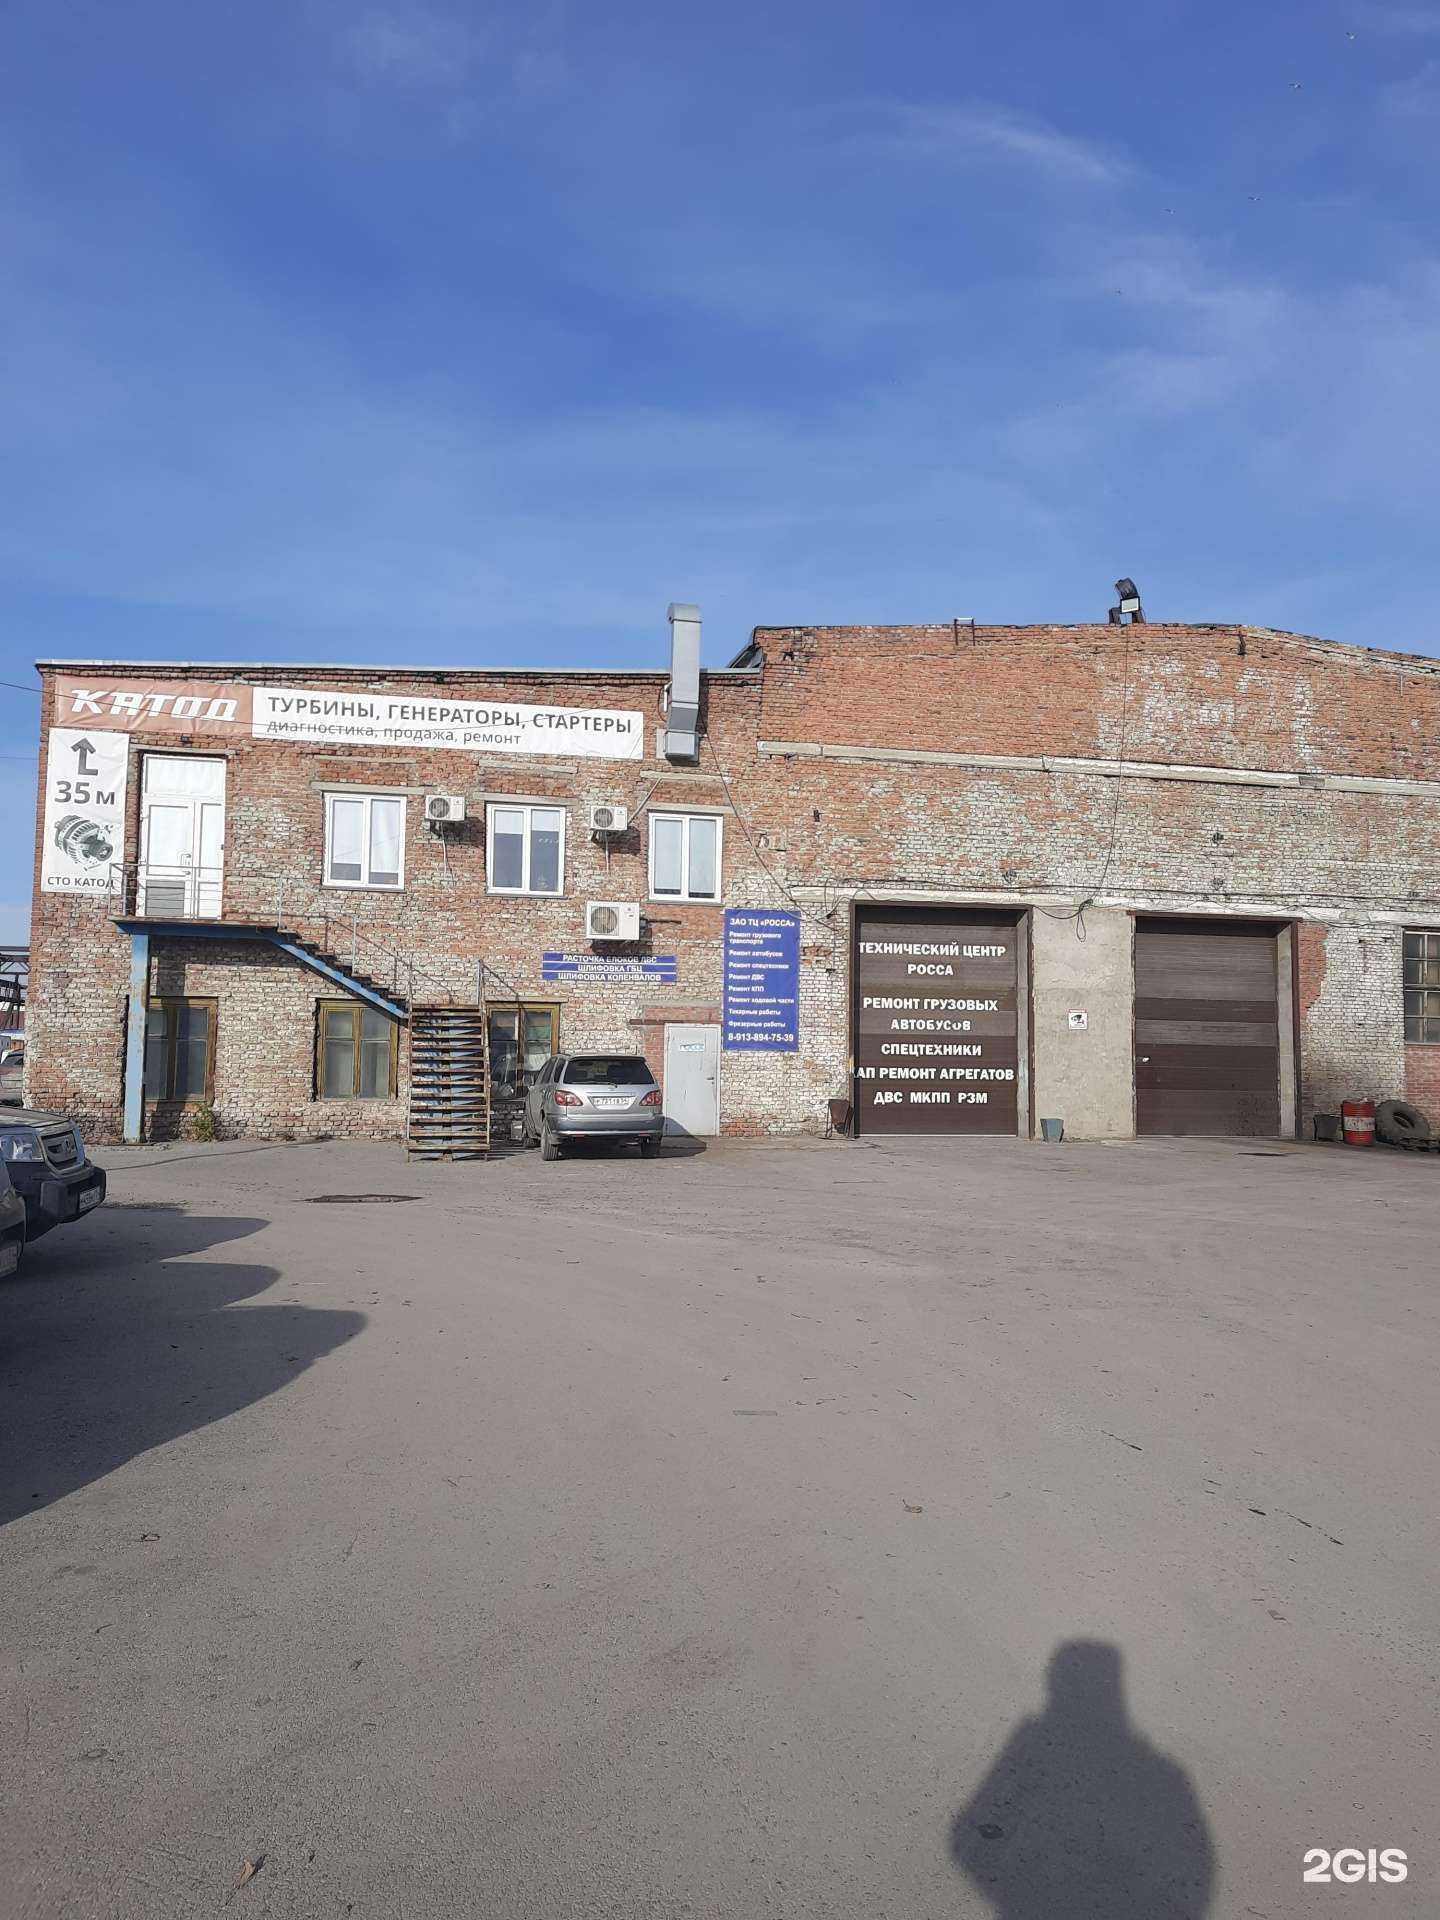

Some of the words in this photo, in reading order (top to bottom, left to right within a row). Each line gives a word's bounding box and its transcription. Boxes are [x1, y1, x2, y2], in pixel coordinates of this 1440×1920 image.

[71, 689, 239, 721] КАТОД
[268, 696, 380, 720] ТУРБИНЫ,
[388, 704, 526, 730] ГЕНЕРАТОРЫ,
[533, 713, 631, 733] СТАРТЕРЫ
[267, 720, 378, 738] диагностика,
[384, 728, 458, 743] продажа,
[463, 732, 522, 745] ремонт
[54, 780, 91, 804] 35
[47, 876, 71, 886] СТО
[74, 877, 114, 890] КАТОД
[729, 918, 747, 926] ЗАО
[748, 919, 759, 927] ТЦ
[760, 919, 796, 927] «РОССА»
[858, 941, 959, 956] ТЕХНИЧЕСКИЙ
[963, 945, 1006, 958] ЦЕНТР
[562, 954, 604, 963] РАСТОЧКА
[577, 963, 625, 972] ШЛИФОВКА
[626, 964, 643, 973] ГБЦ
[907, 963, 954, 976] РОССА
[558, 972, 606, 981] ШЛИФОВКА
[607, 973, 662, 981] КОЛЕНВАЛОВ
[863, 997, 920, 1009] РЕМОНТ
[924, 998, 999, 1011] ГРУЗОВЫХ
[728, 1032, 794, 1042] 8-913-894-75-39
[881, 1043, 982, 1057] СПЕЦТЕХНИКИ
[855, 1067, 875, 1079] АП
[879, 1067, 936, 1079] РЕМОНТ
[940, 1069, 1014, 1080] АГРЕГАТОВ
[873, 1091, 903, 1104] ДВС
[910, 1092, 951, 1103] МКПП
[958, 1092, 988, 1103] РЗМ
